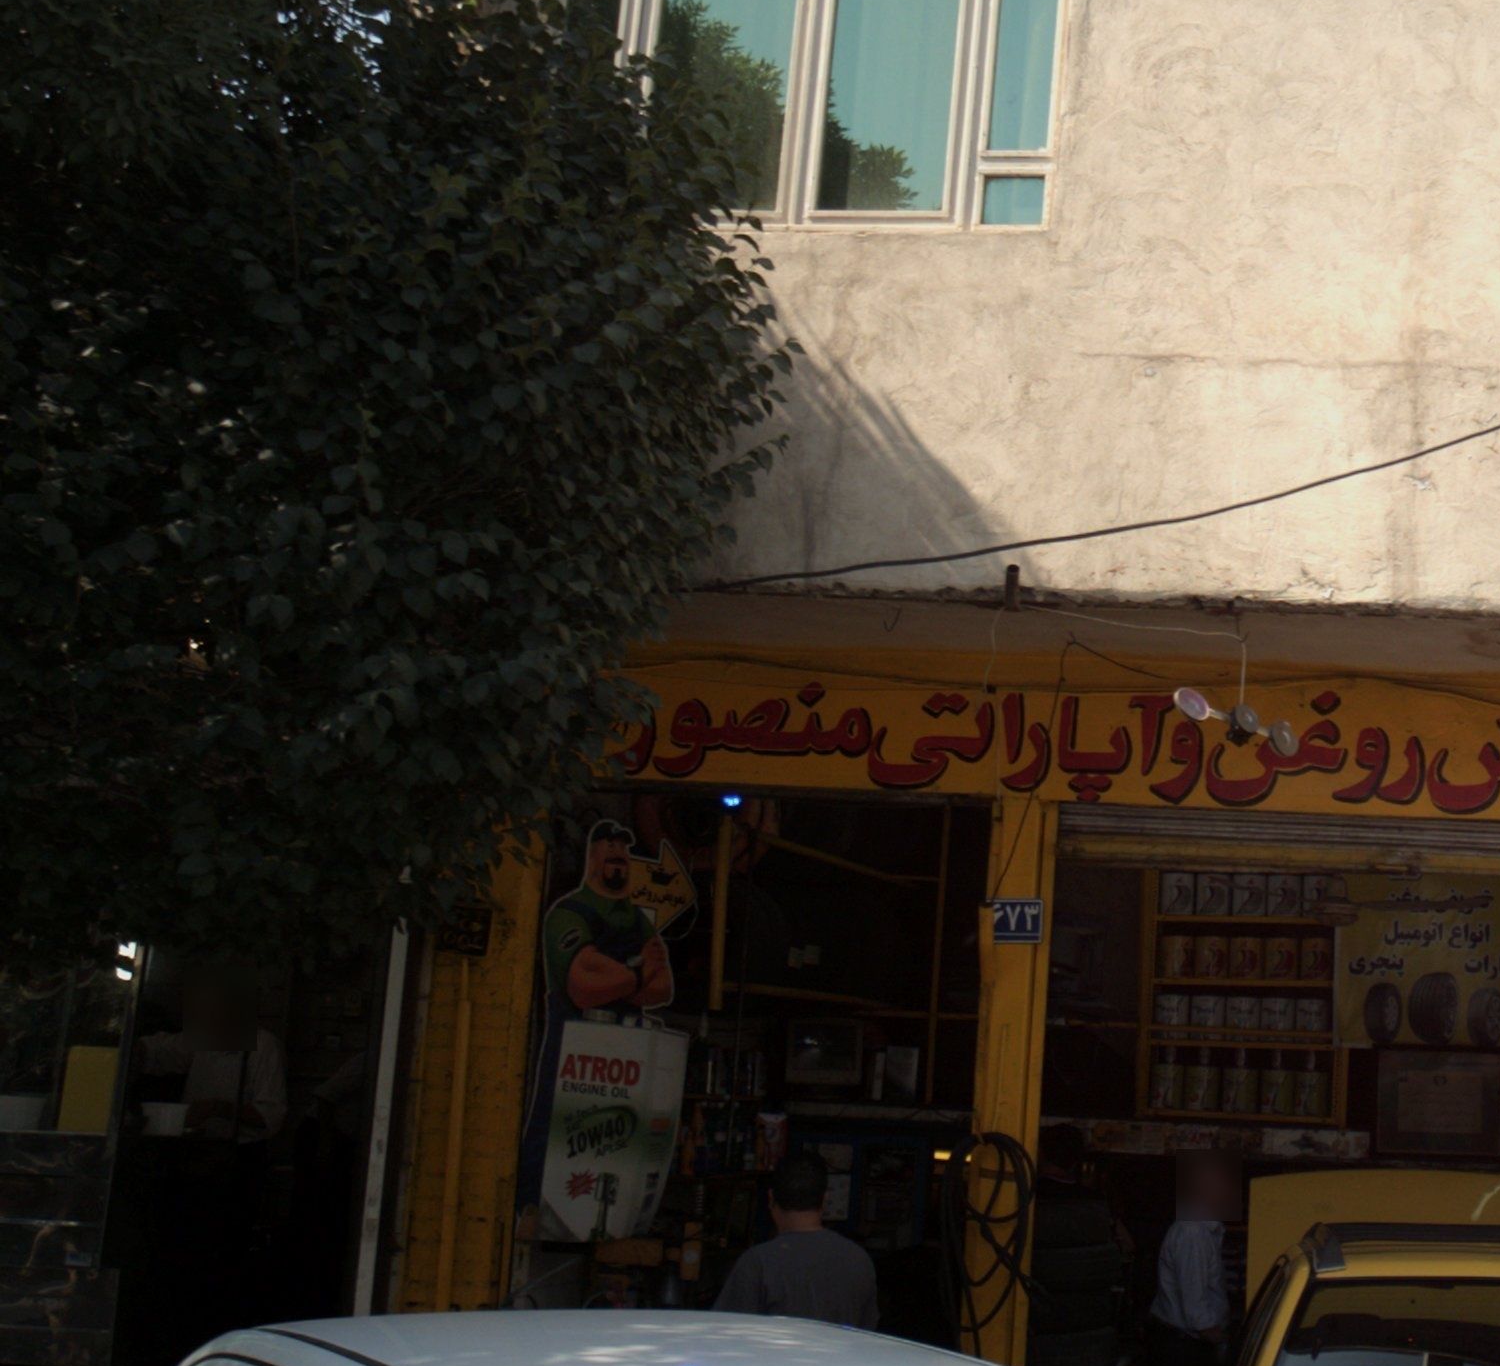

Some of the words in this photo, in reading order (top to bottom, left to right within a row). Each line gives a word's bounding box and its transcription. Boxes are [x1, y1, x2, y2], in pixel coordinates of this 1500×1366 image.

[869, 690, 1177, 801] آپاراتی
[1206, 690, 1425, 807] روغن
[1448, 922, 1491, 949] انواع
[560, 1053, 641, 1088] ATROD
[561, 1080, 608, 1097] ENGINE
[611, 1085, 632, 1100] OIL
